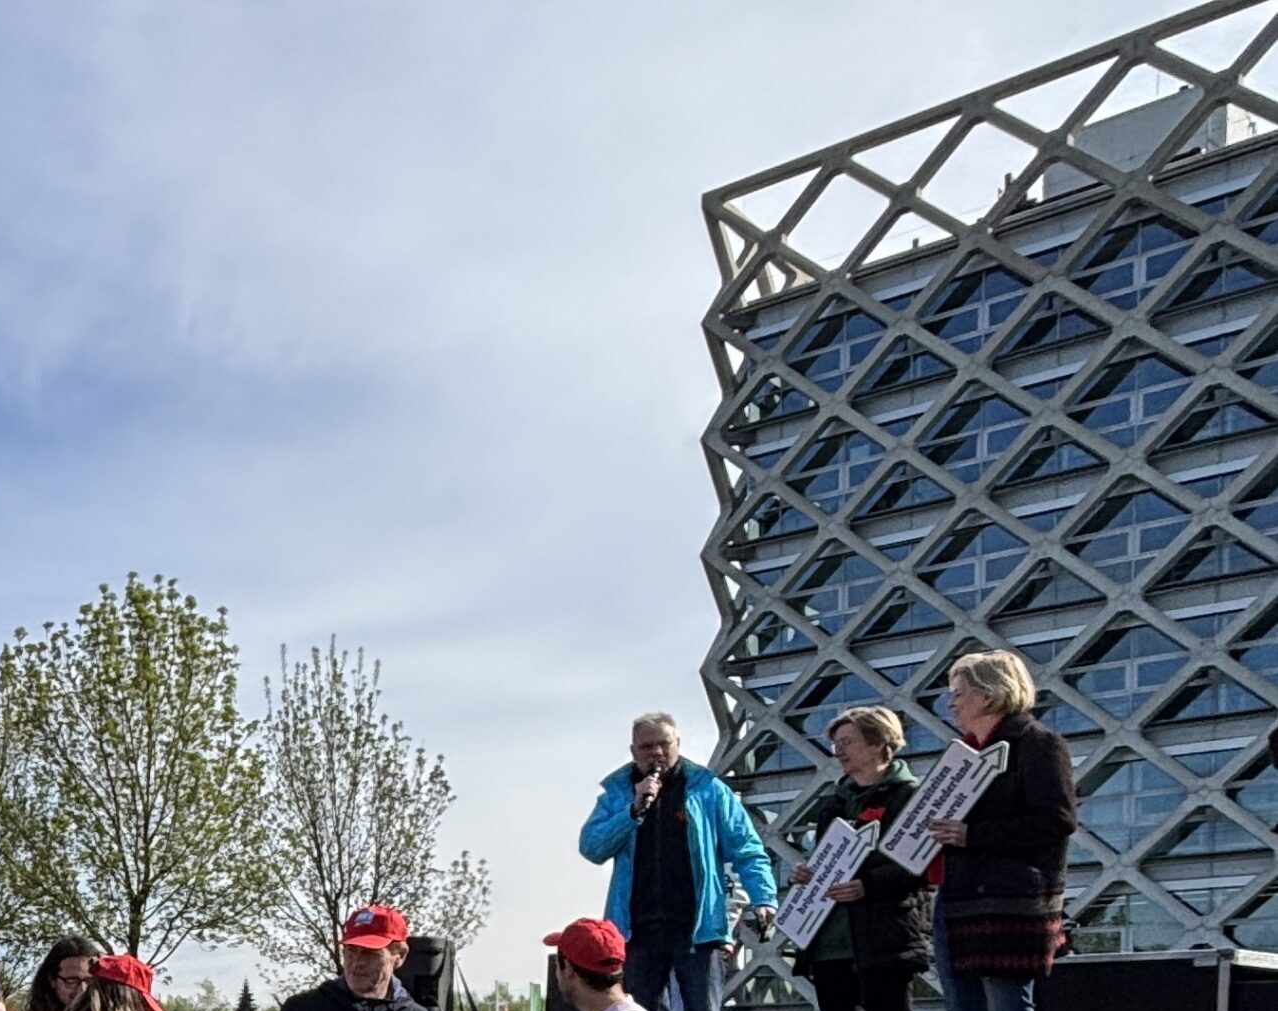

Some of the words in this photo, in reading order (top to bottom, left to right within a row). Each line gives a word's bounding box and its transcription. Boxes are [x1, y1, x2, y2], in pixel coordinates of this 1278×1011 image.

[885, 828, 905, 852] Onze
[903, 765, 951, 829] universiteiten
[933, 759, 973, 809] Nederland
[796, 883, 821, 915] helpen
[818, 837, 851, 884] Nederland
[778, 903, 794, 925] Onze
